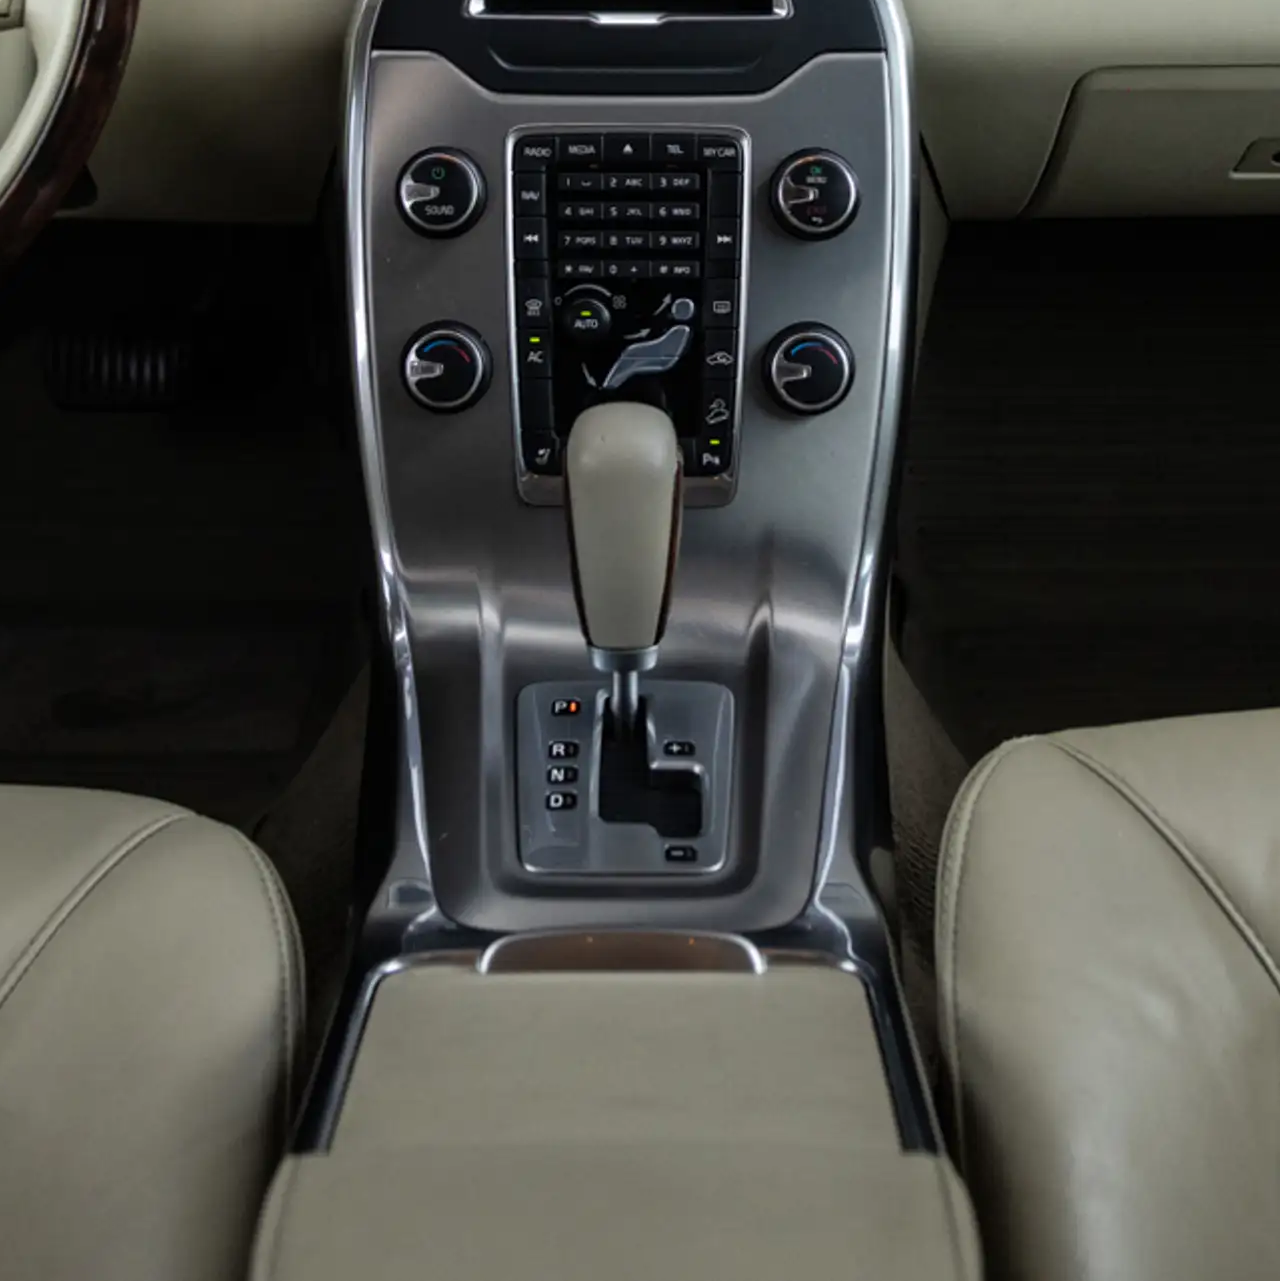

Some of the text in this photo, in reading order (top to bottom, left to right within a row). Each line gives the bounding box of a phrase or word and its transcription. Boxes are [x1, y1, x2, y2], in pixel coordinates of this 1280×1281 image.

[524, 146, 552, 157] RADIO
[568, 145, 596, 155] MEDIA
[666, 145, 684, 155] TEL
[609, 177, 643, 187] 2 ABC
[660, 177, 691, 187] 3 DEF
[425, 204, 455, 216] SOUND
[565, 206, 572, 216] 4
[610, 207, 618, 217] 5
[659, 207, 667, 217] 6
[565, 236, 571, 245] 7
[625, 236, 643, 245] TUV
[659, 236, 667, 246] 9
[574, 319, 599, 329] AUTO
[527, 351, 544, 363] AC
[554, 701, 568, 713] P
[552, 744, 565, 756] R
[551, 769, 565, 782] N
[549, 794, 563, 807] D
